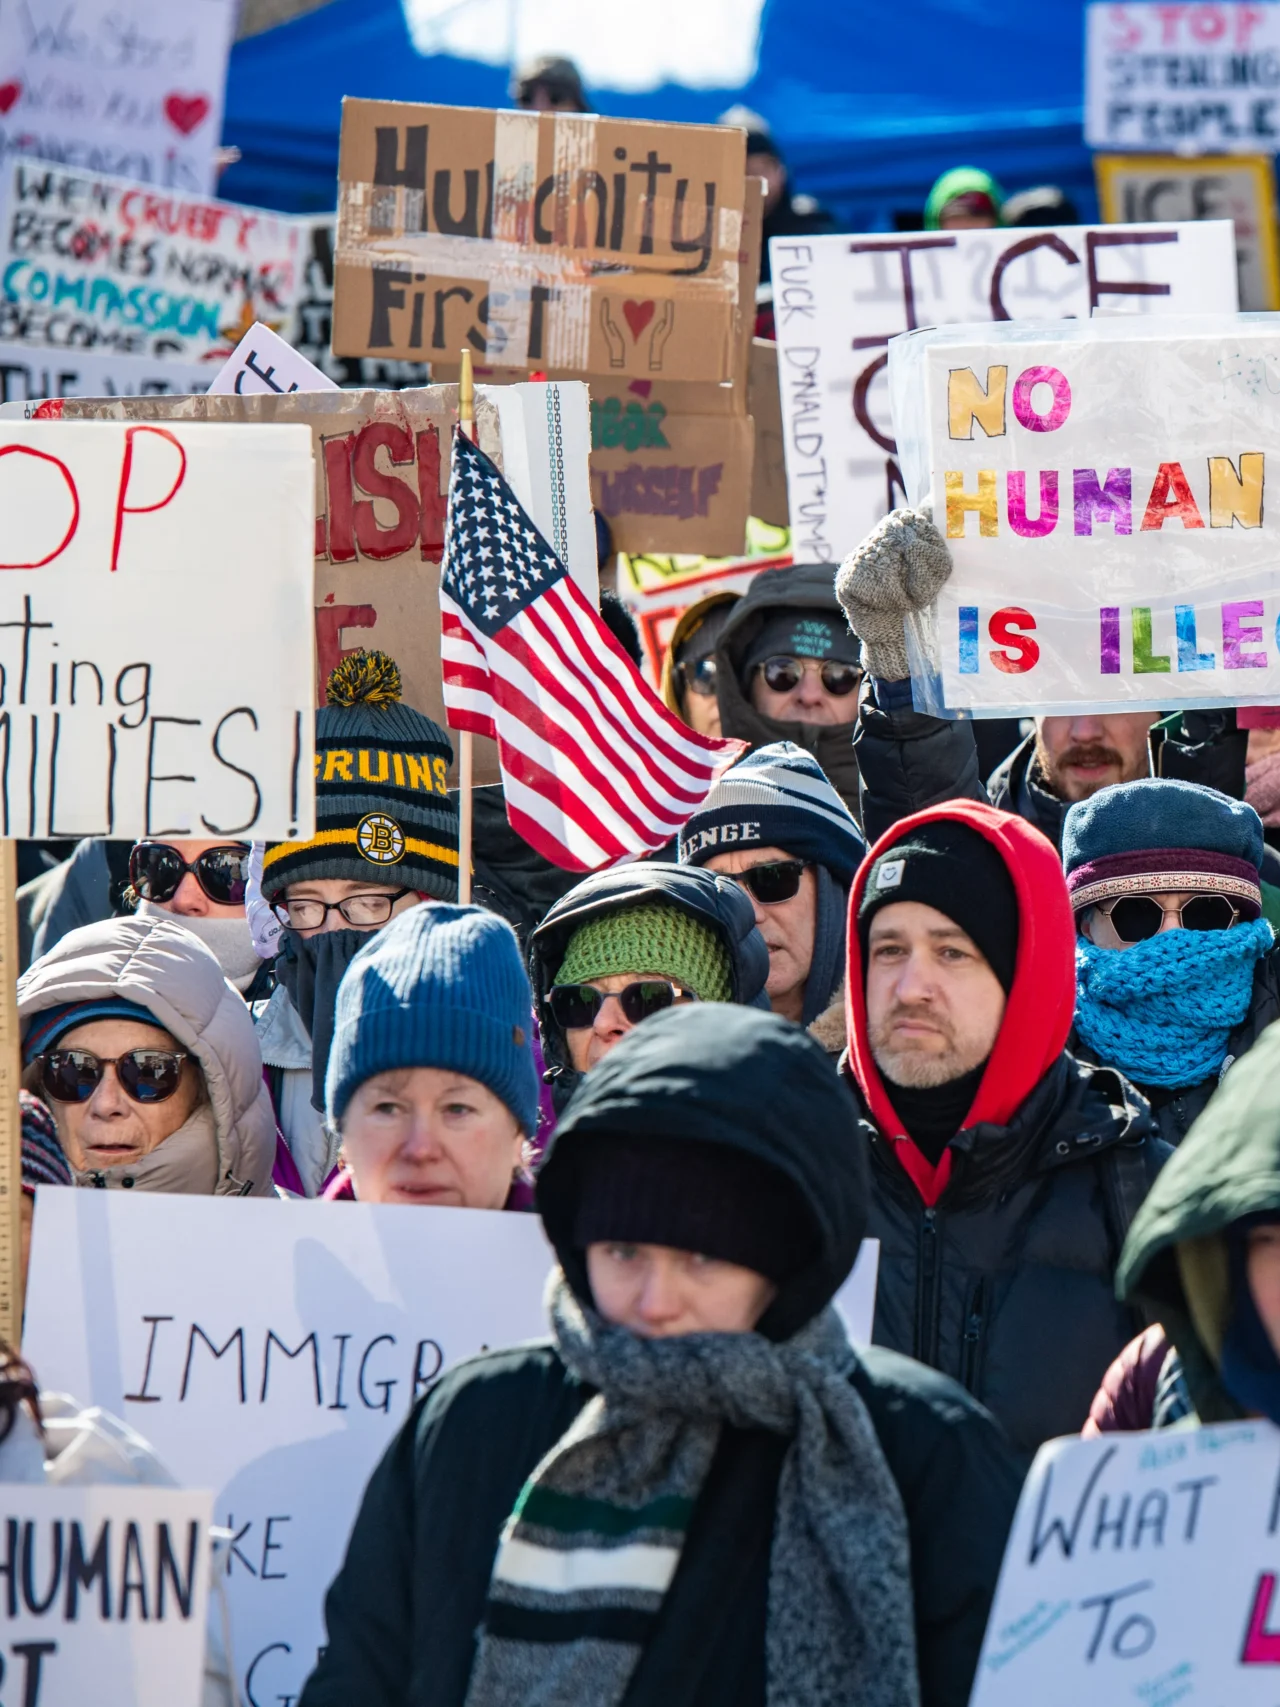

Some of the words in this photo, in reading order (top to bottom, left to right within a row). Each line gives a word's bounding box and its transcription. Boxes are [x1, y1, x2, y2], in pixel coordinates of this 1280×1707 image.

[1107, 3, 1266, 48] STOP
[1105, 101, 1280, 139] PEOPLE
[367, 259, 561, 361] First
[777, 246, 815, 327] FUCK
[948, 364, 1073, 441] NO
[0, 424, 187, 572] OP
[944, 452, 1265, 539] HUMAN
[0, 594, 151, 729] ting
[957, 605, 1041, 676] IS
[0, 707, 303, 839] ILIES!
[315, 749, 448, 796] RUINS
[124, 1315, 447, 1414] IMMIGR
[224, 1513, 292, 1581] KE
[1025, 1443, 1220, 1568] WHAT
